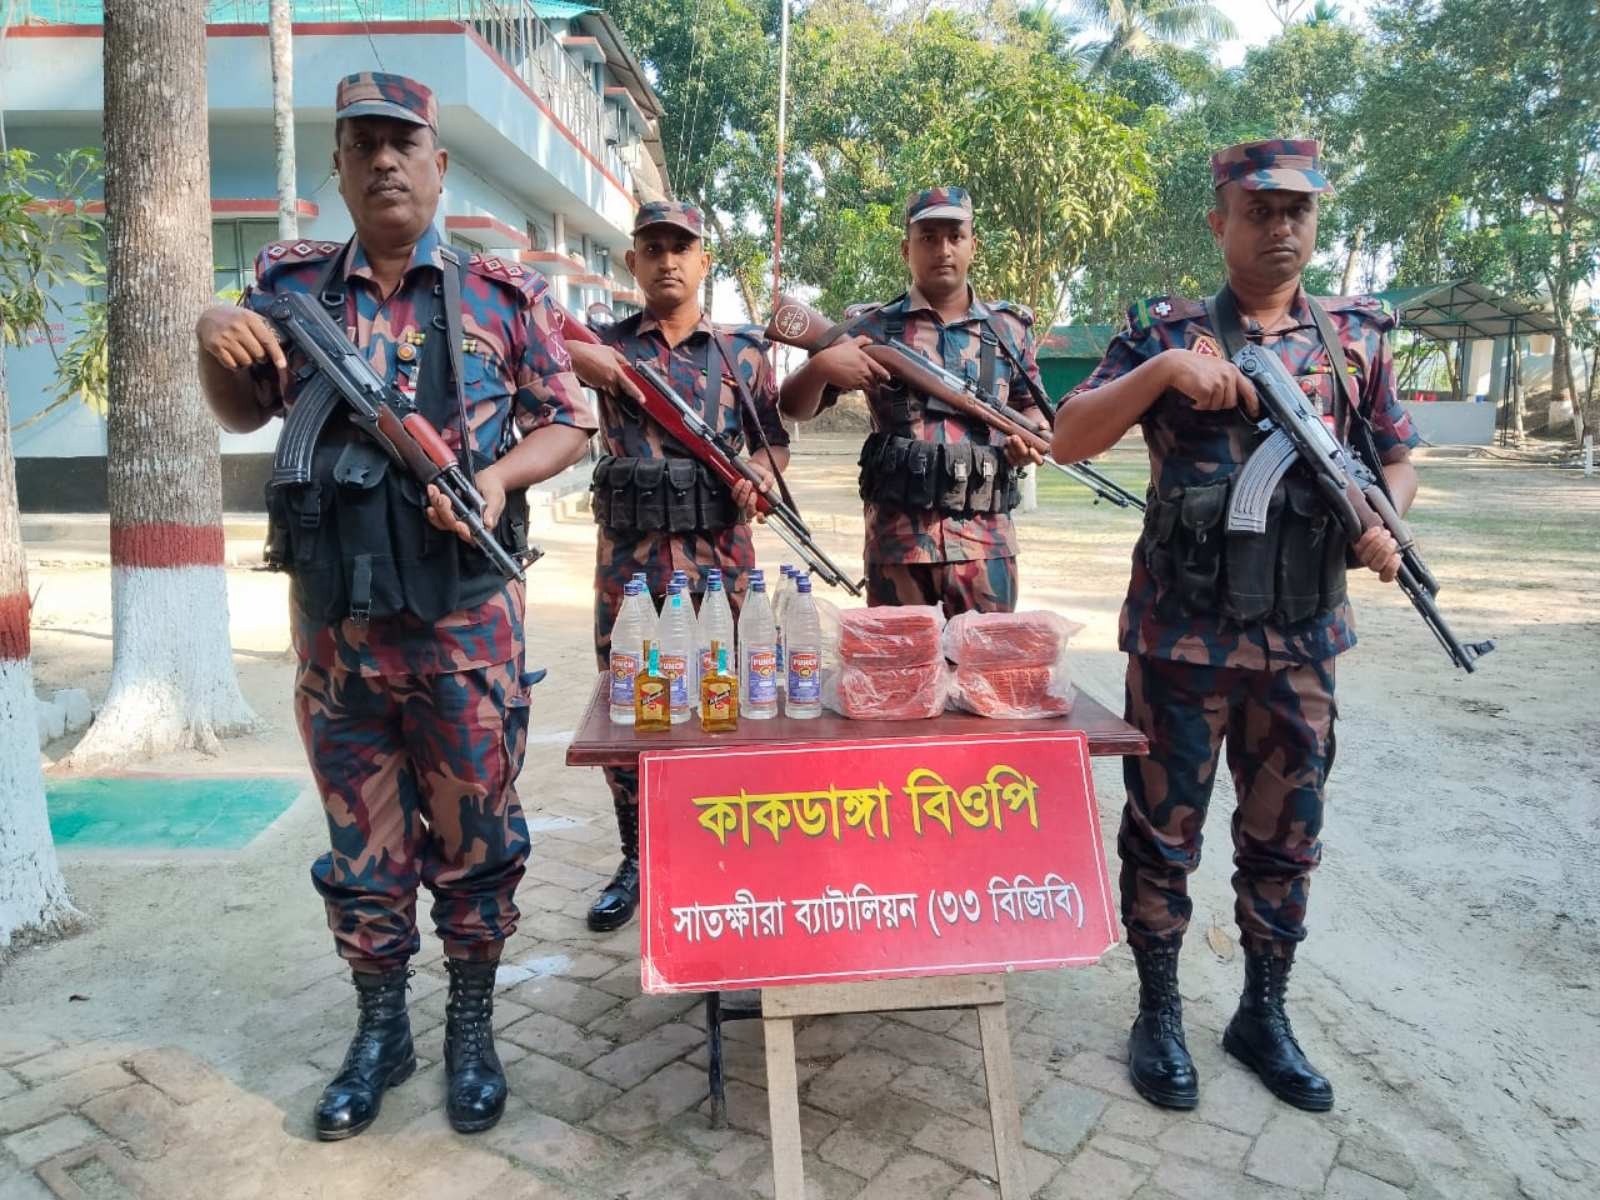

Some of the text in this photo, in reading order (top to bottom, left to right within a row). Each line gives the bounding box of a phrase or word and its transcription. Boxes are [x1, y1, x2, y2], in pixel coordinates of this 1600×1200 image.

[692, 764, 1039, 846] কাকডাঙ্গা বিওপি
[670, 873, 1085, 942] সাতক্ষীরা ব্যাটালিয়ন (৩৩ বিজিবি)
